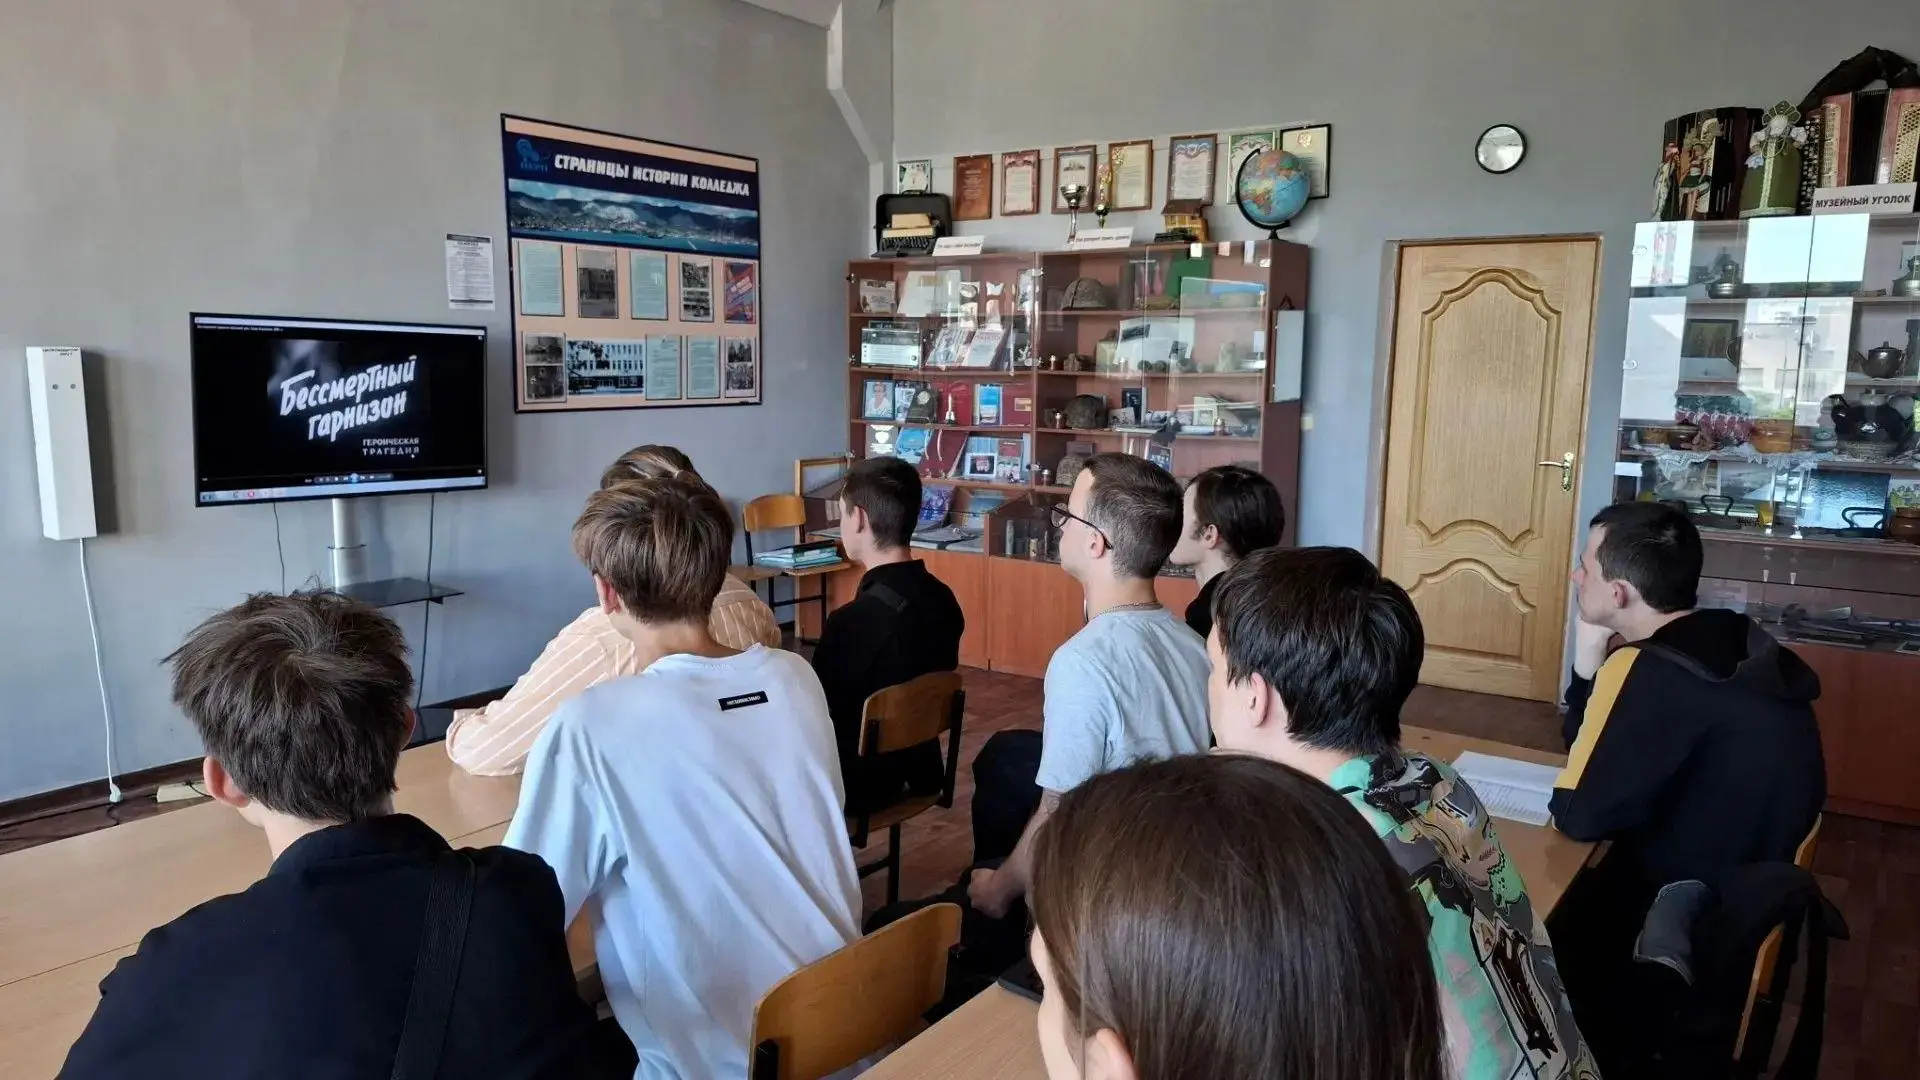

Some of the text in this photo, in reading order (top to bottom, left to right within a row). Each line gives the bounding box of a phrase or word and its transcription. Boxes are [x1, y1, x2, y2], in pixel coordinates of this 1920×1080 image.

[554, 154, 630, 179] СТРАНИЦЫ
[632, 165, 689, 188] ИСТОРИИ
[690, 175, 750, 197] КОЛЛЕДЖА
[1815, 194, 1912, 208] МУЗЕЙНЫЙ УГОЛОК
[280, 355, 417, 416] Бессмертный
[308, 390, 407, 442] гарнизон
[362, 437, 420, 446] ГЕРОИЧЕСКАЯ
[362, 446, 420, 456] ТРАГЕДИЯ
